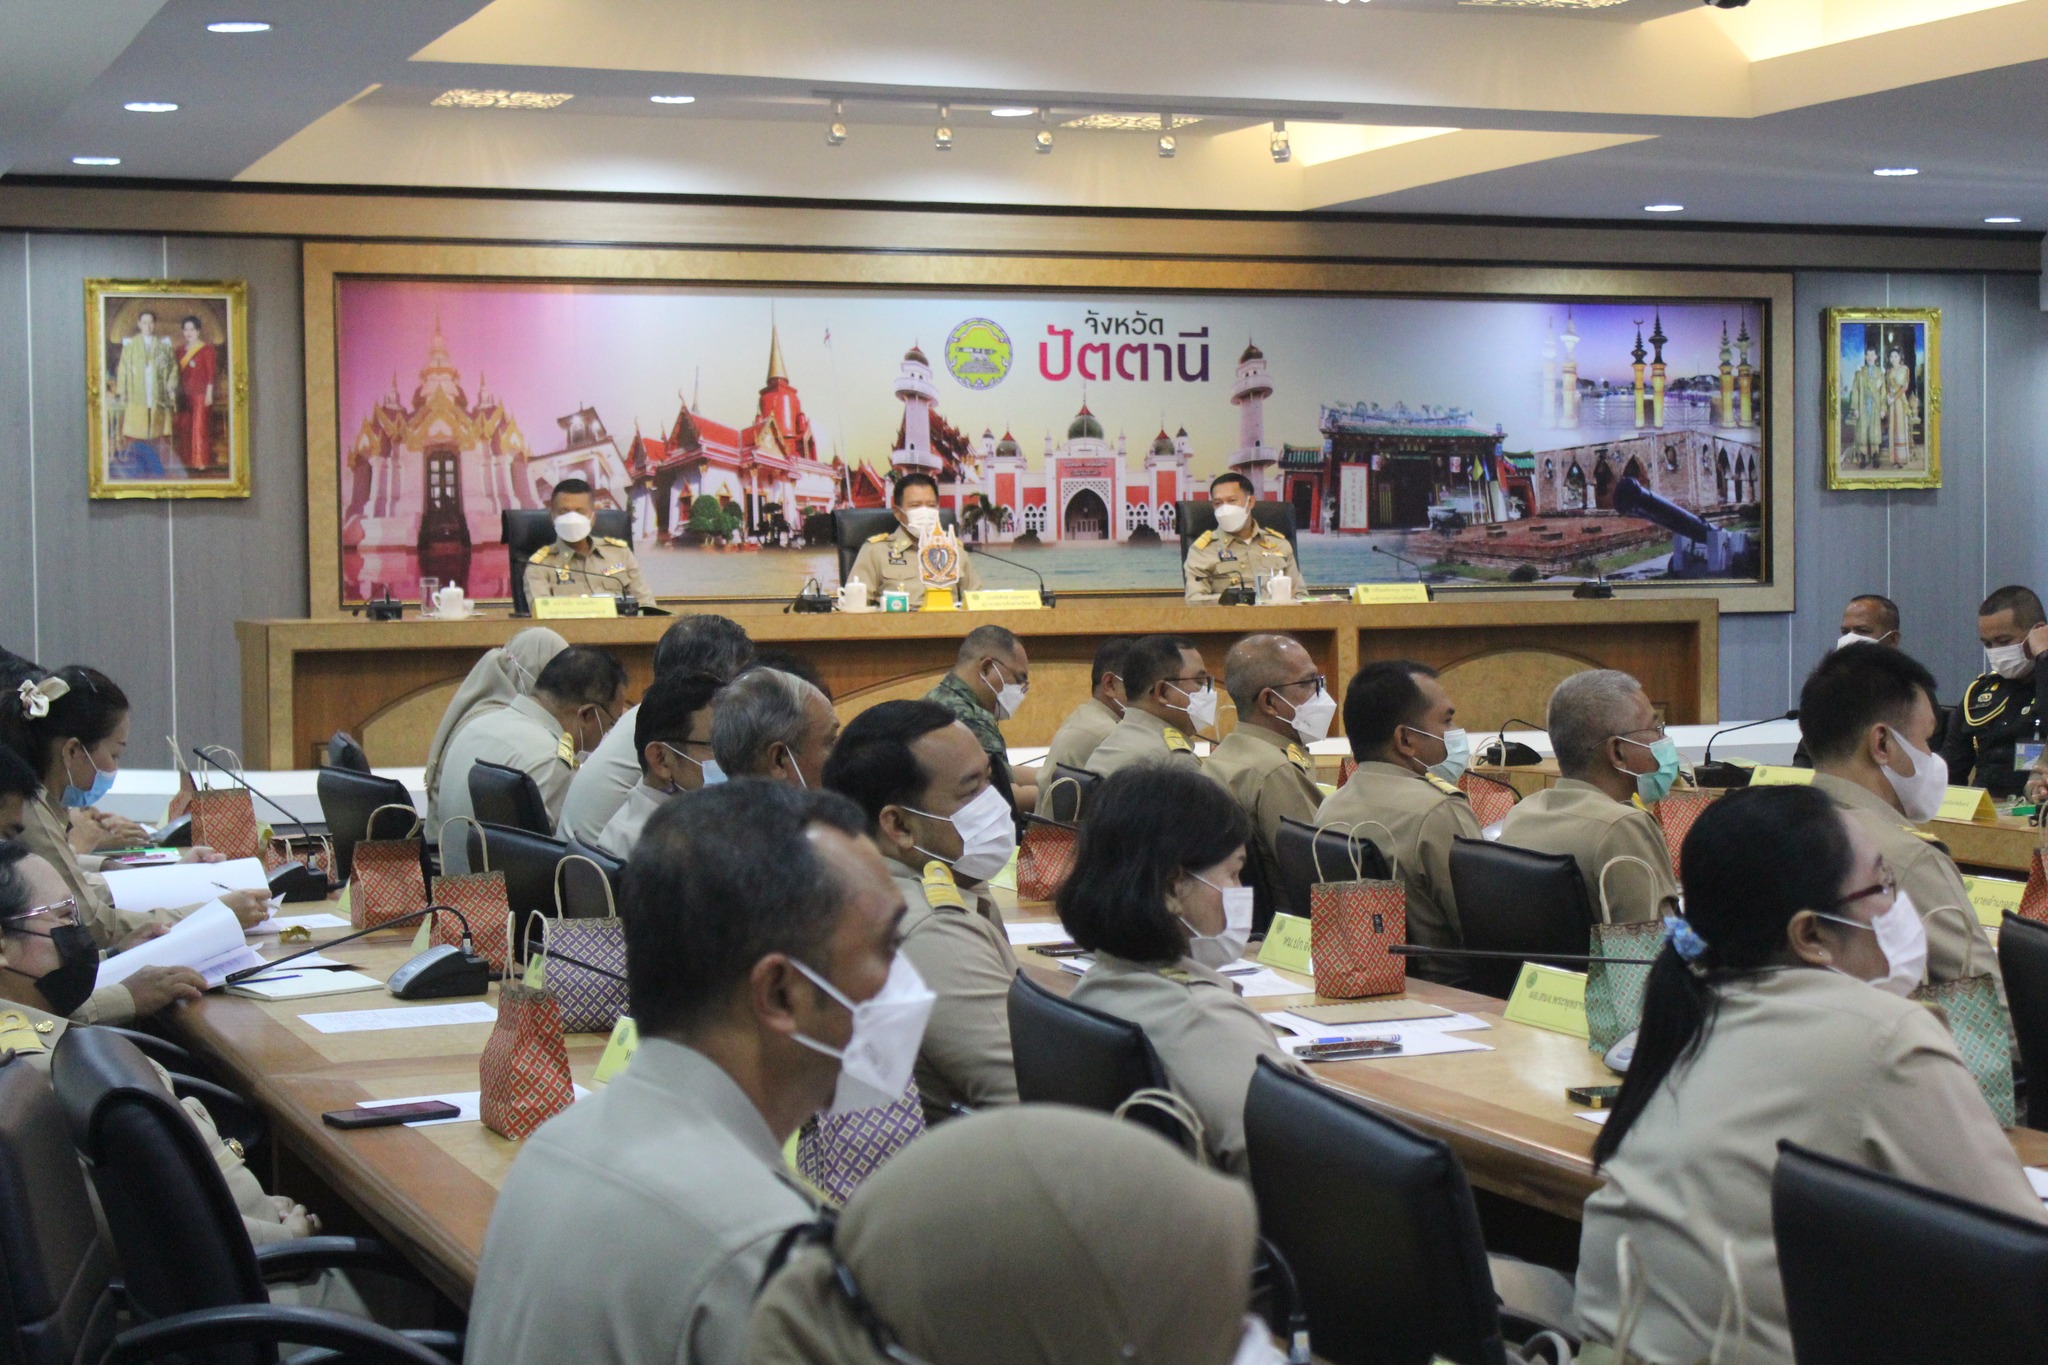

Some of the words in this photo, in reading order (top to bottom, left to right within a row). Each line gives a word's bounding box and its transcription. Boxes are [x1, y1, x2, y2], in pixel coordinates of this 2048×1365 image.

[1085, 310, 1164, 335] จังหวัด
[1039, 325, 1209, 382] ปัตตานี
